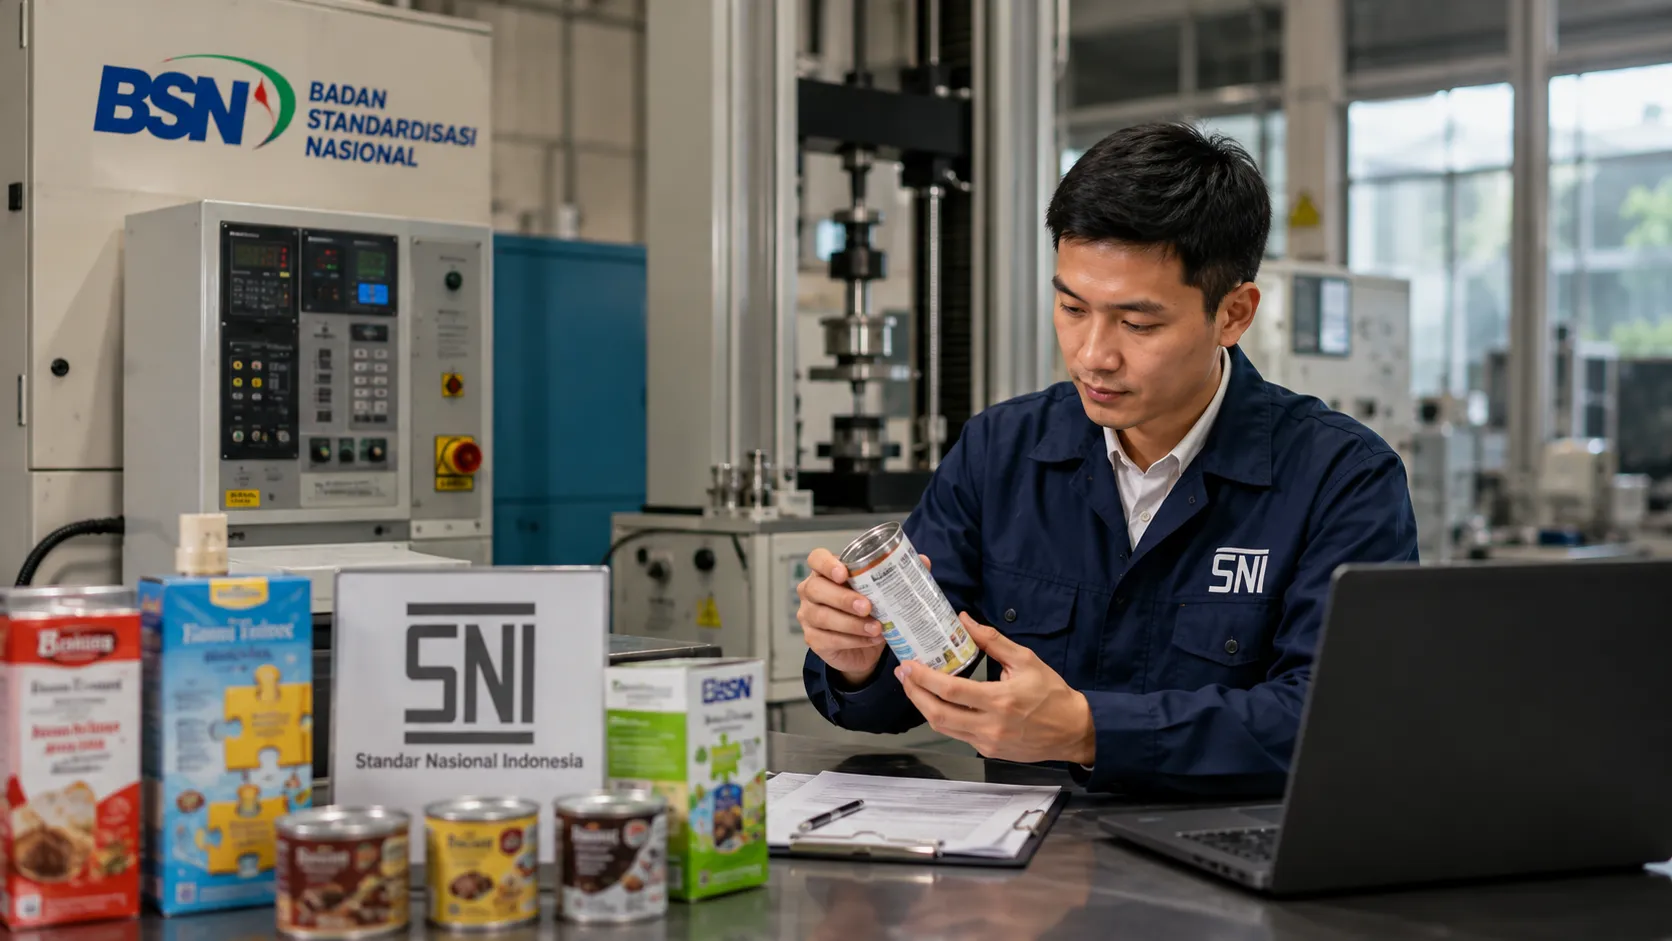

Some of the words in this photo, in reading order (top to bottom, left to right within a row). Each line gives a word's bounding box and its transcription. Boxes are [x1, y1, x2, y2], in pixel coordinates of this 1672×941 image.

[93, 65, 250, 145] BSN
[308, 81, 387, 110] BADAN
[307, 108, 478, 147] STANDARDISASI
[305, 135, 418, 167] NASIONAL
[1208, 553, 1269, 594] SNI
[404, 624, 535, 724] SNI
[355, 752, 421, 769] Standar
[426, 752, 497, 769] Nasional
[502, 752, 584, 769] Indonesia
